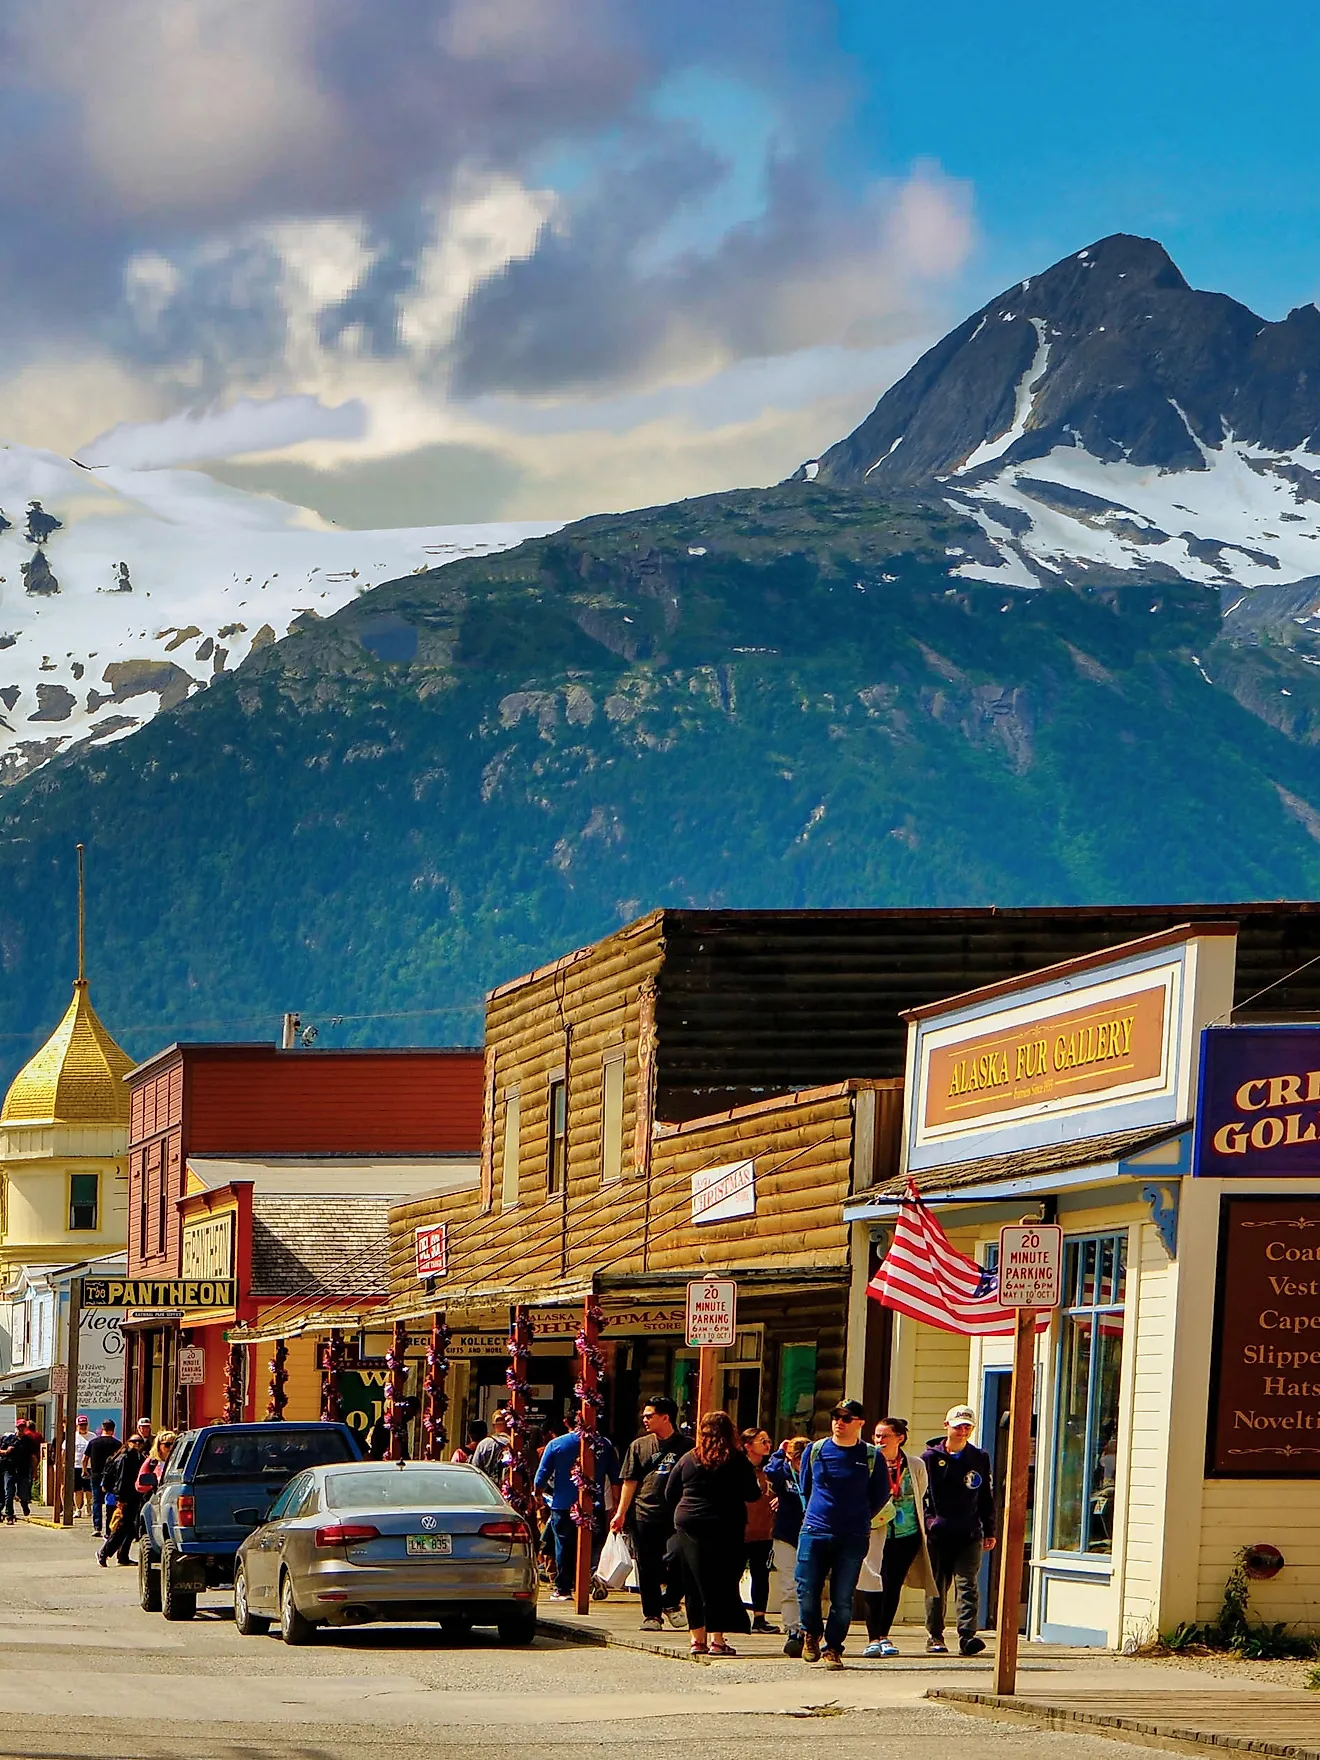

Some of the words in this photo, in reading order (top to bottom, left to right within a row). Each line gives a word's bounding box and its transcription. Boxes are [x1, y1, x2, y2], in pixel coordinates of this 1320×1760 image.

[949, 1051, 1009, 1096] ALASKA
[1015, 1040, 1047, 1080] FUR
[1054, 1017, 1135, 1071] GALLERY
[1021, 1235, 1040, 1248] 20
[1010, 1252, 1049, 1263] MINUTE
[1006, 1267, 1053, 1280] PARKING
[87, 1286, 106, 1300] The
[108, 1282, 230, 1305] PANTHEON
[704, 1288, 718, 1299] 20
[696, 1302, 726, 1311] MINUTE
[530, 1313, 575, 1321] ALASKA
[692, 1314, 729, 1324] PARKING
[643, 1322, 681, 1330] STORE
[460, 1336, 508, 1346] KOLLECT
